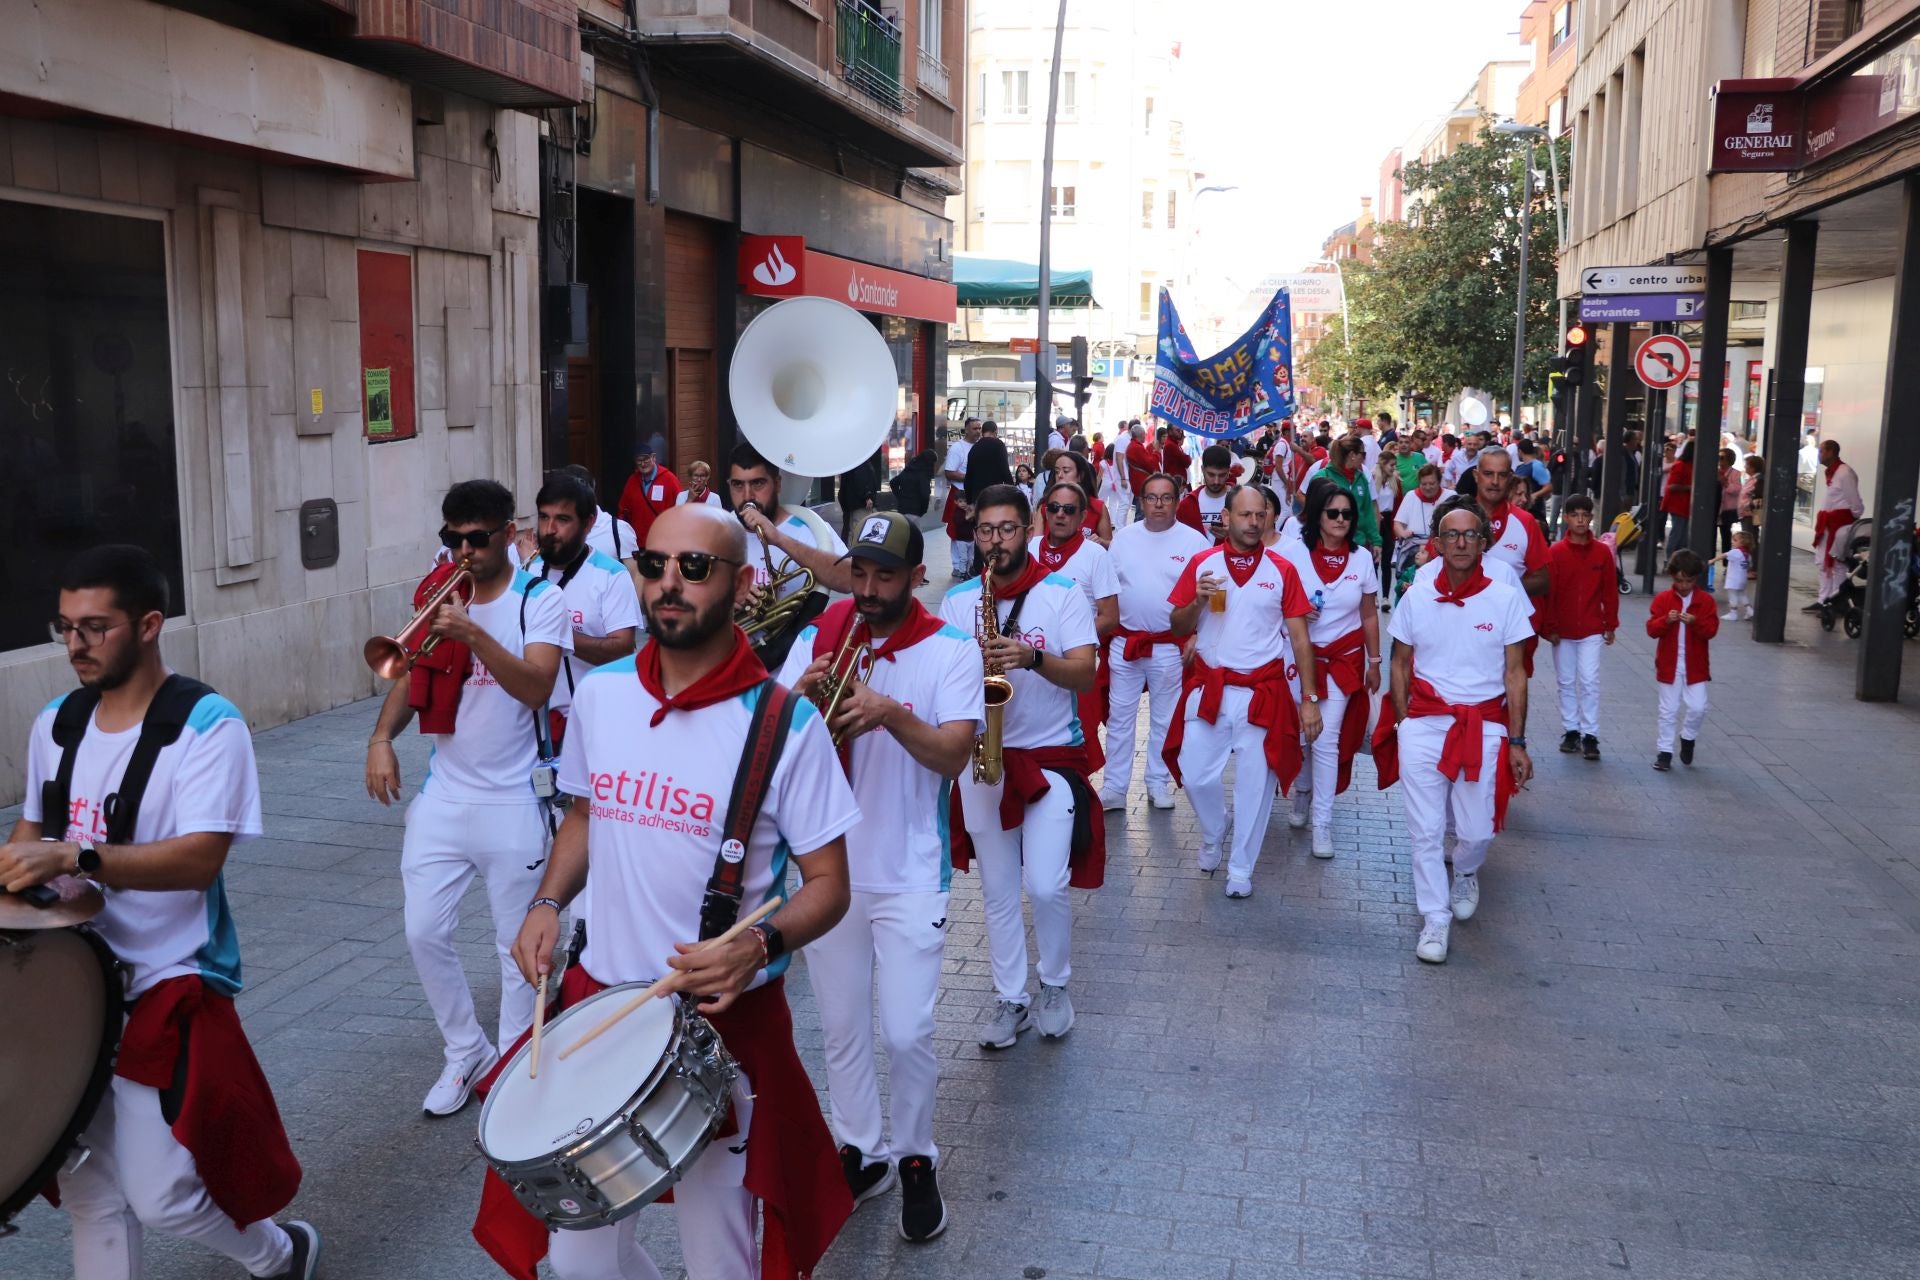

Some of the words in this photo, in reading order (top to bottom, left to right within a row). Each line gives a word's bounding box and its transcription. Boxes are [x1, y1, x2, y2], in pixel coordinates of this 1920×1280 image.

[1724, 135, 1793, 151] GENERALI
[1806, 127, 1836, 158] Seguros
[1741, 150, 1775, 159] Seguros
[1629, 275, 1668, 284] centro
[860, 277, 898, 307] Santander
[1582, 298, 1608, 306] teatro
[1582, 307, 1641, 318] Cervantes
[638, 813, 710, 837] adhesivas
